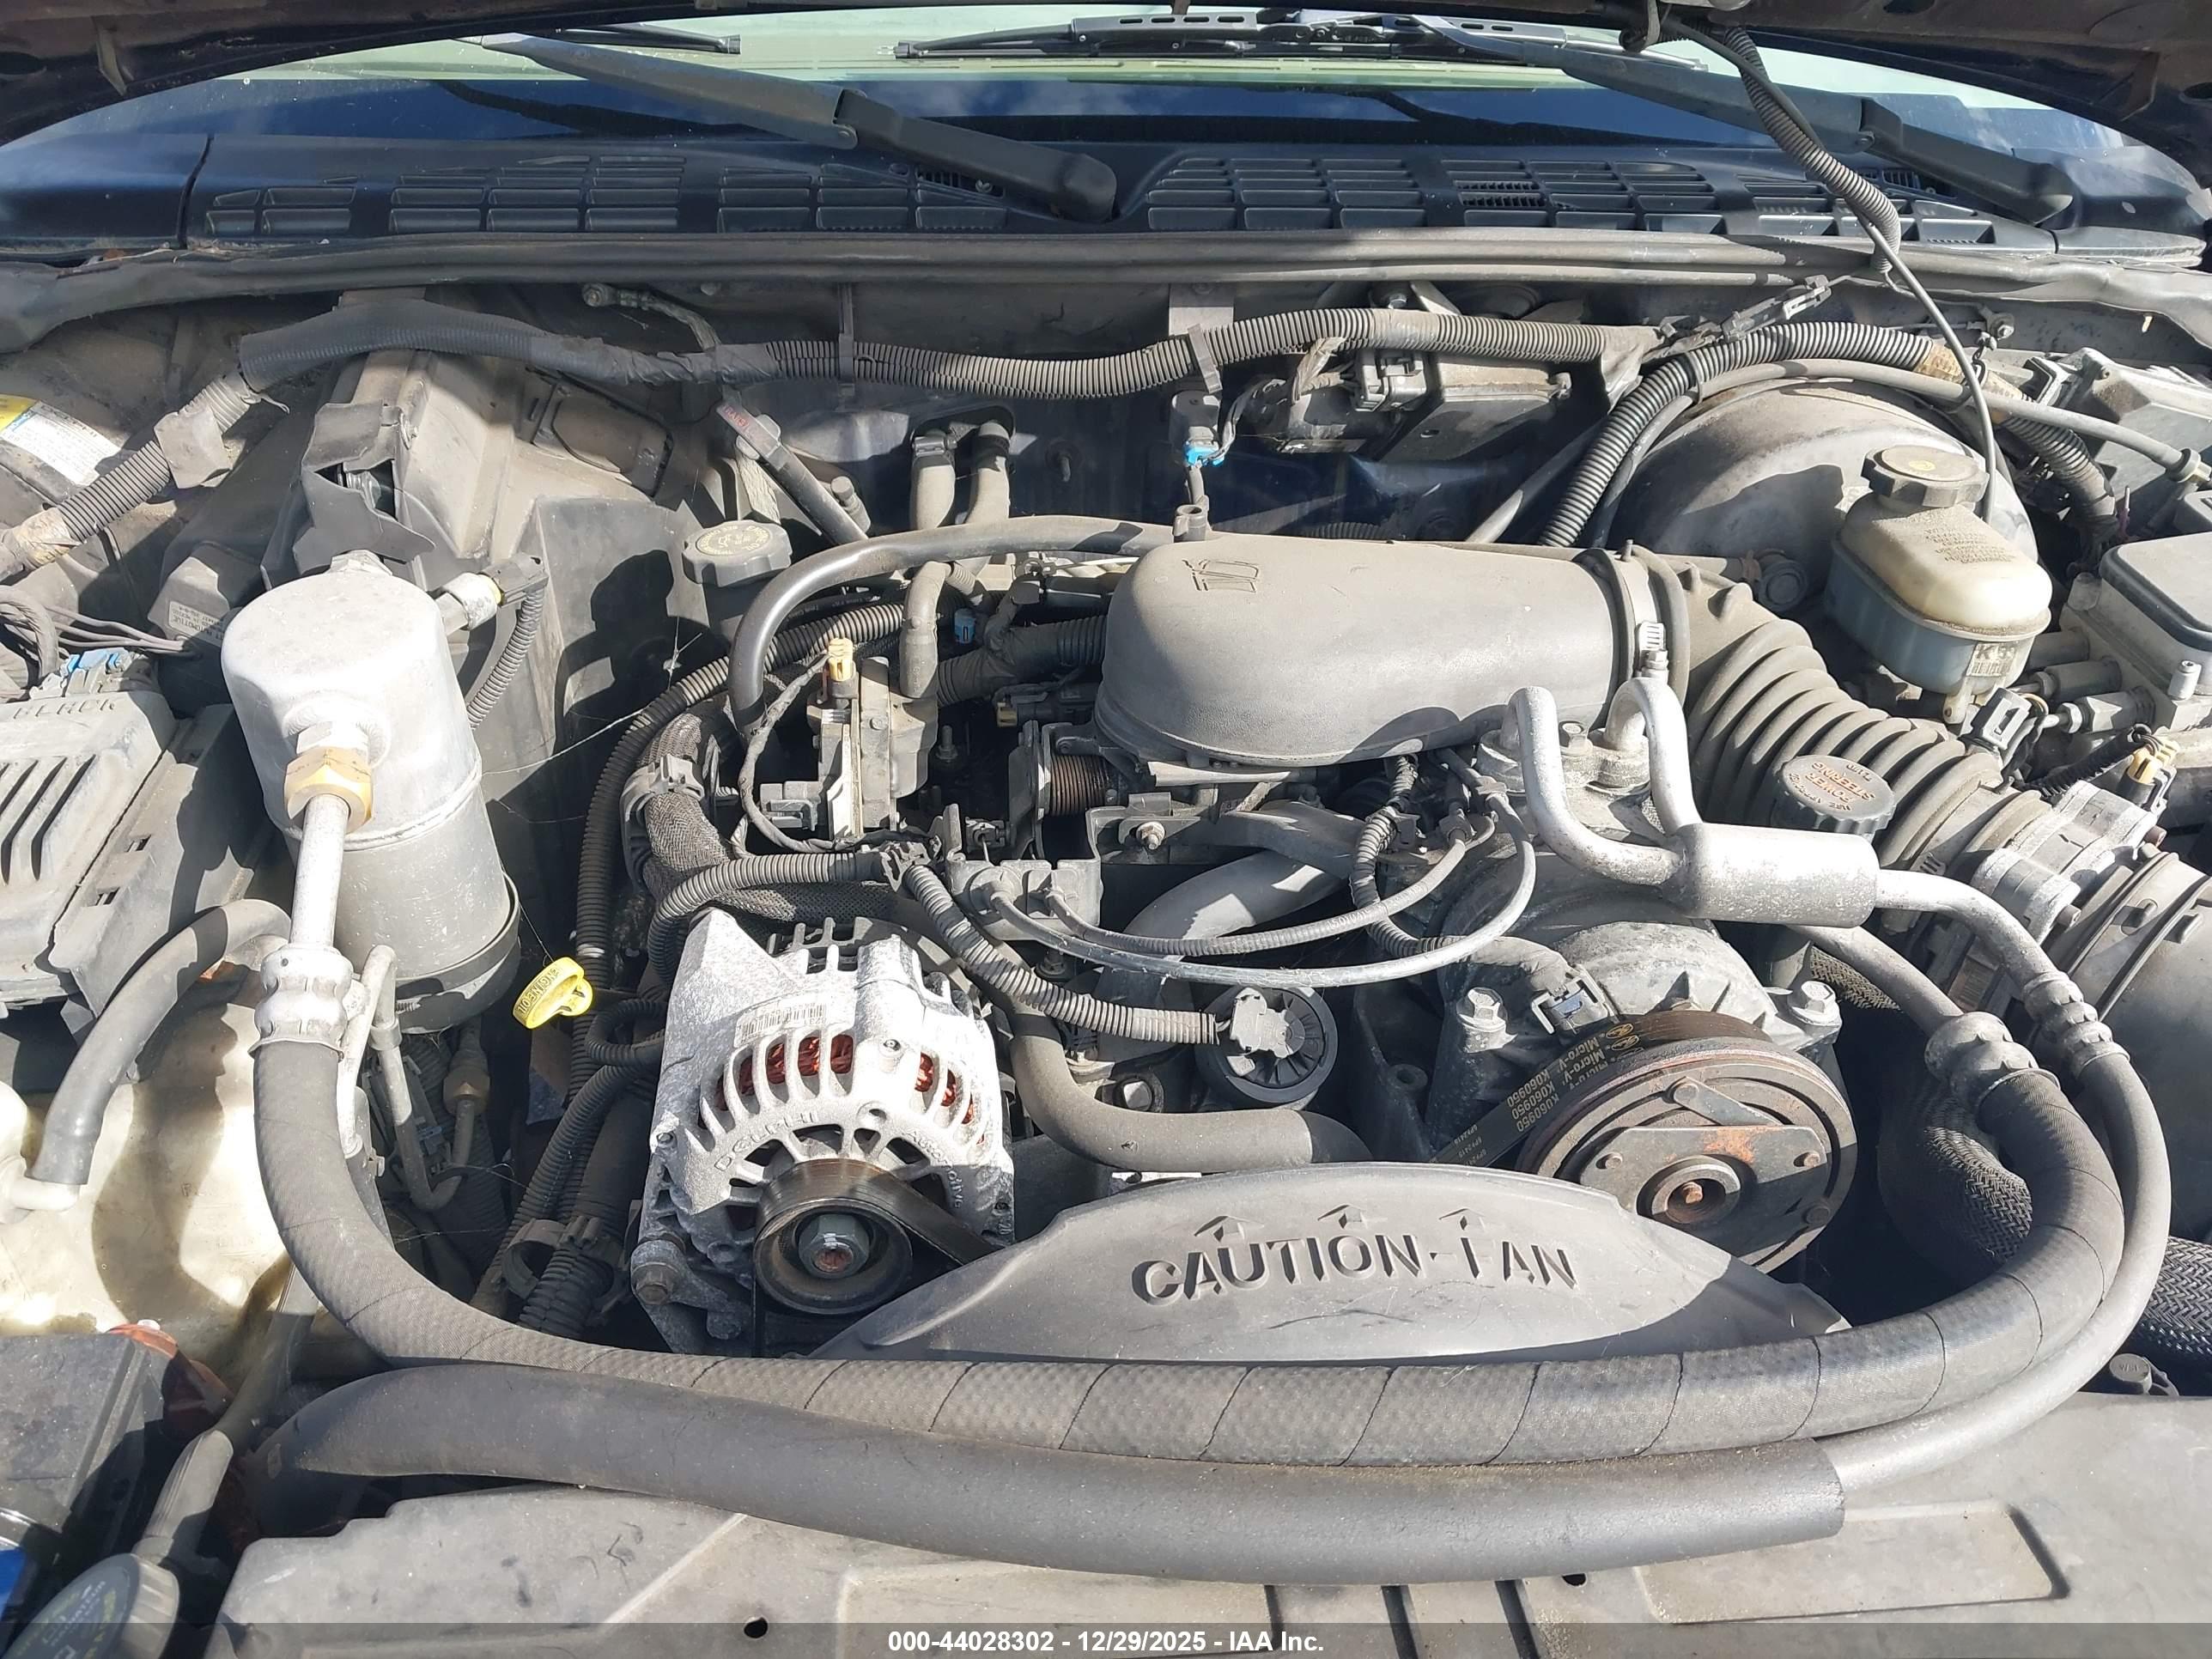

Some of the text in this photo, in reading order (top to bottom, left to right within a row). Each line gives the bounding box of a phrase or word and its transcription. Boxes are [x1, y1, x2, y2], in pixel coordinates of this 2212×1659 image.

[1804, 773, 1853, 804] POWER
[1810, 762, 1876, 801] STEERING
[517, 966, 559, 1014] ENGINE OIL
[1507, 1068, 1551, 1108] K060950
[1511, 1081, 1556, 1120] K060950
[1516, 1093, 1560, 1132] K060950
